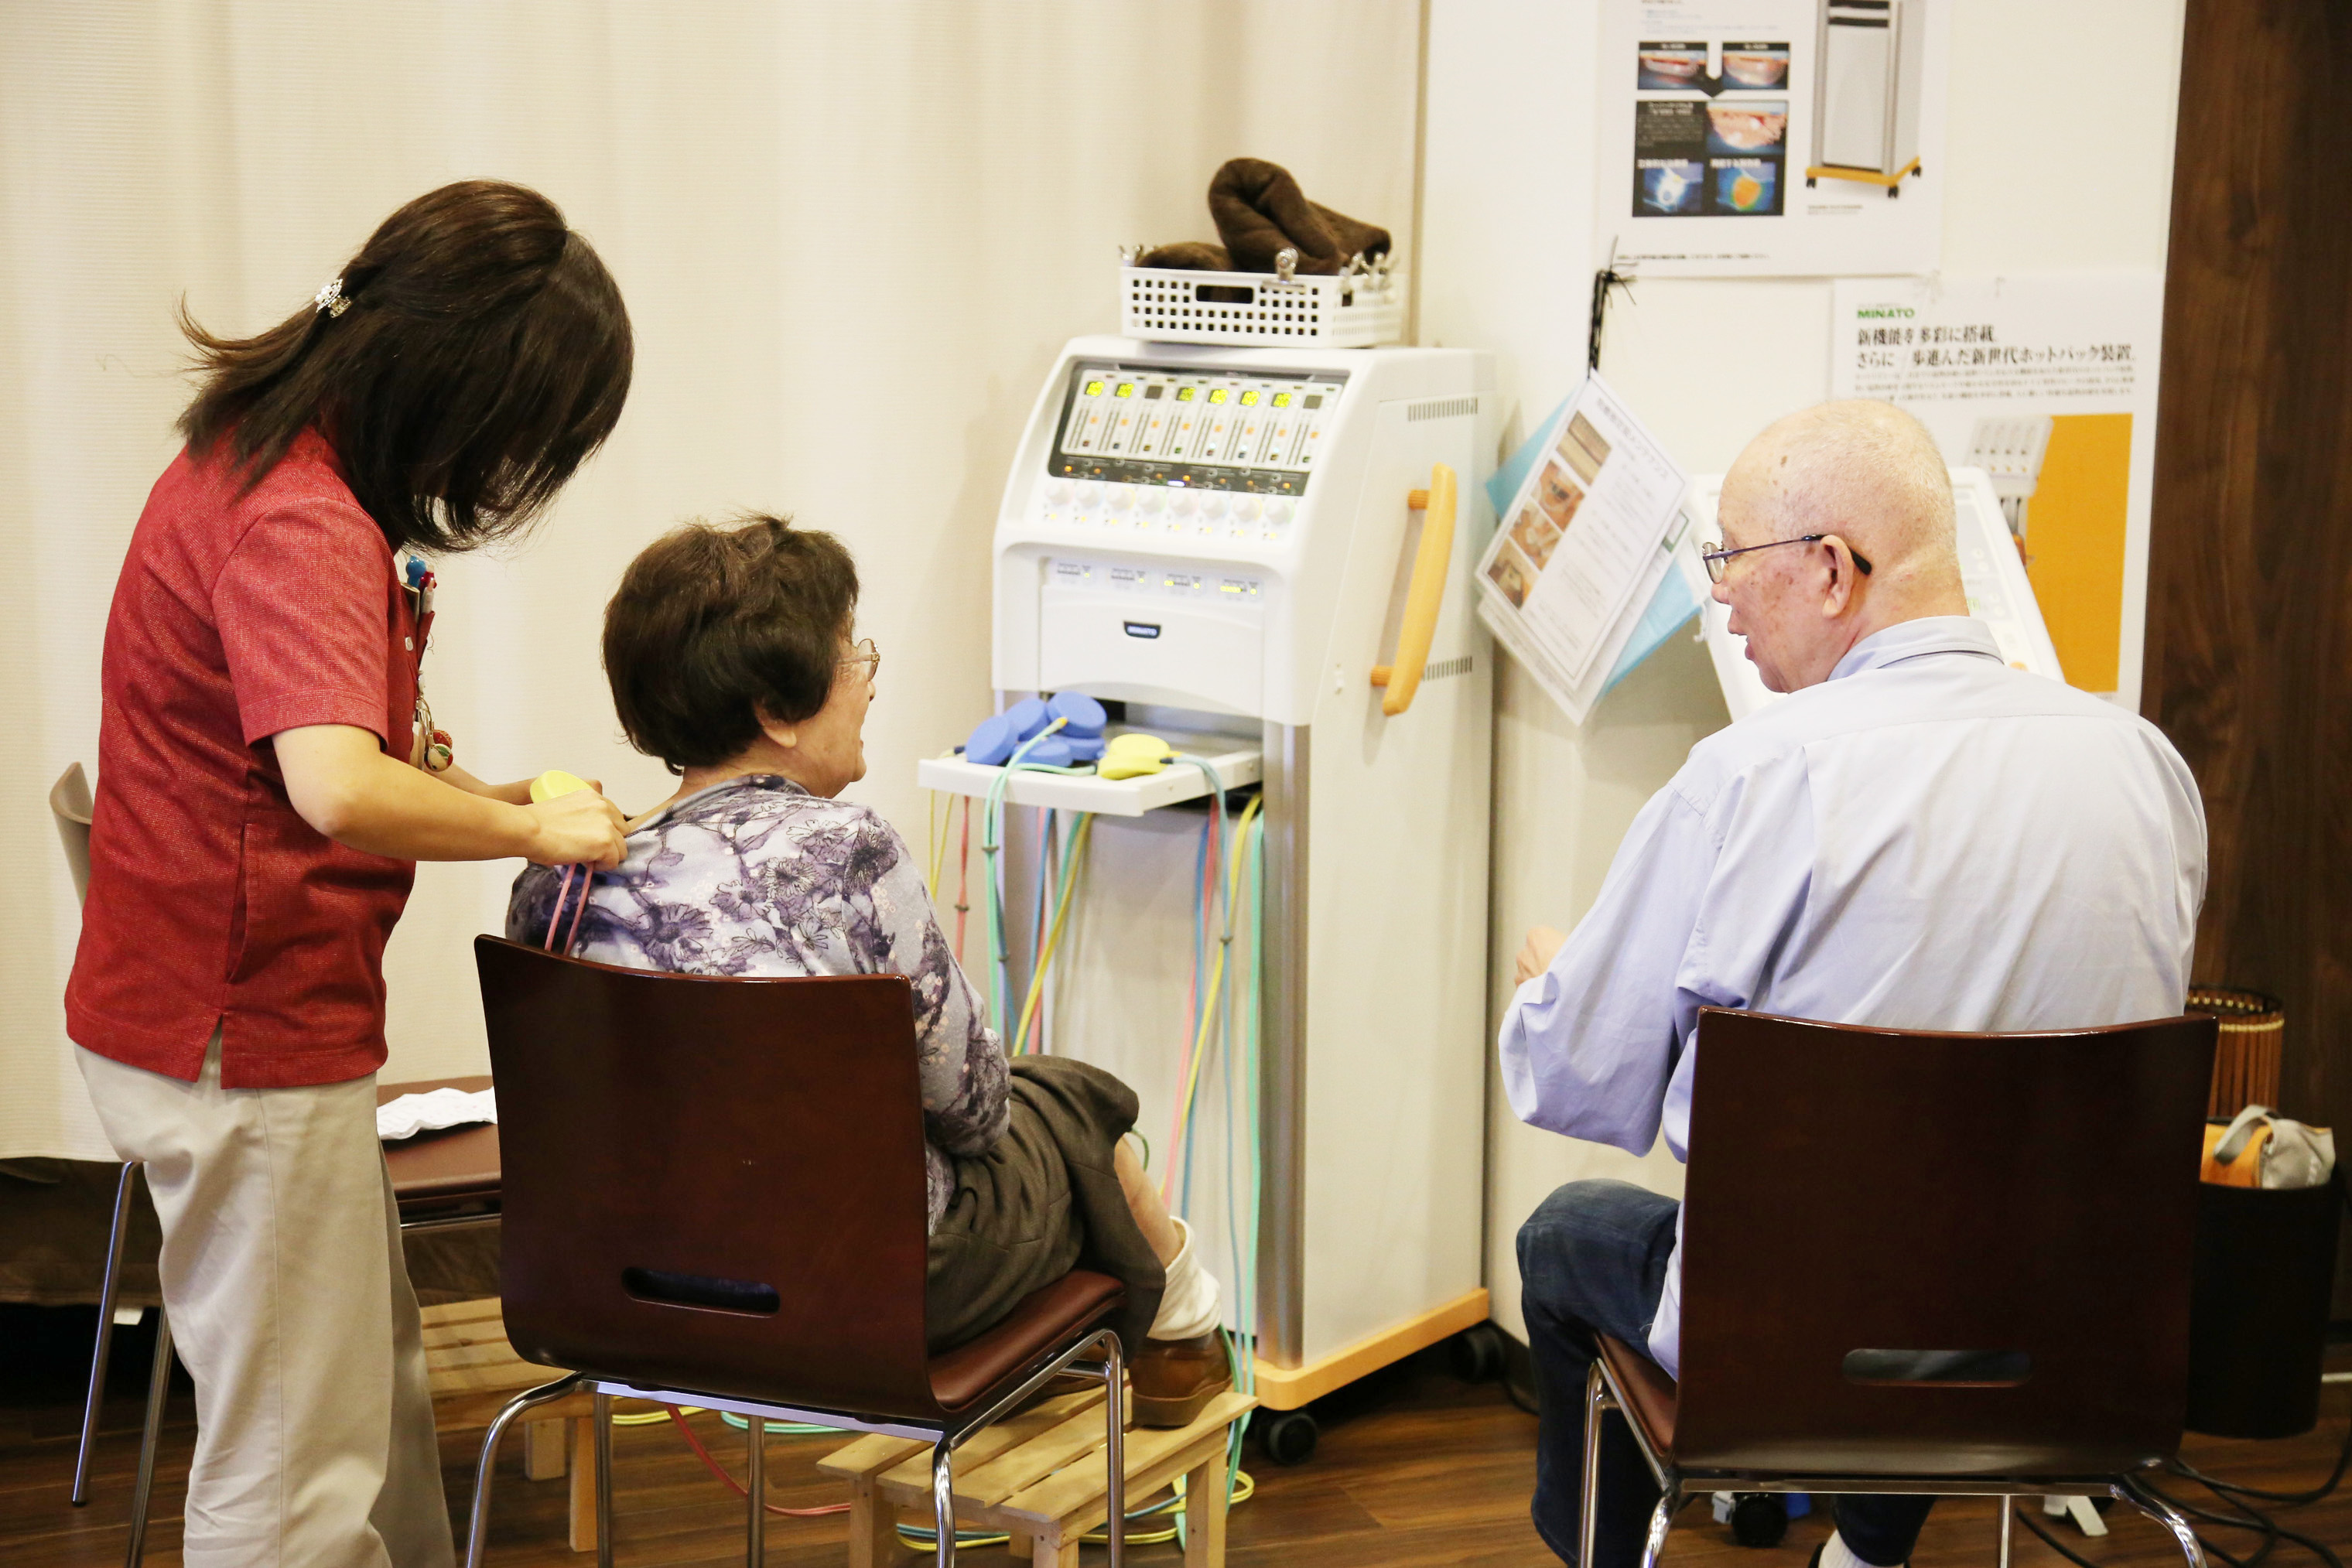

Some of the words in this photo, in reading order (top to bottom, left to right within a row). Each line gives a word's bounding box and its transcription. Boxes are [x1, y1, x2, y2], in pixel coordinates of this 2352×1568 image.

[1858, 307, 1915, 319] MINATO
[1858, 343, 2135, 368] さらに歩進んだ新世代ホットパック装置。
[1126, 625, 1157, 637] ATO
